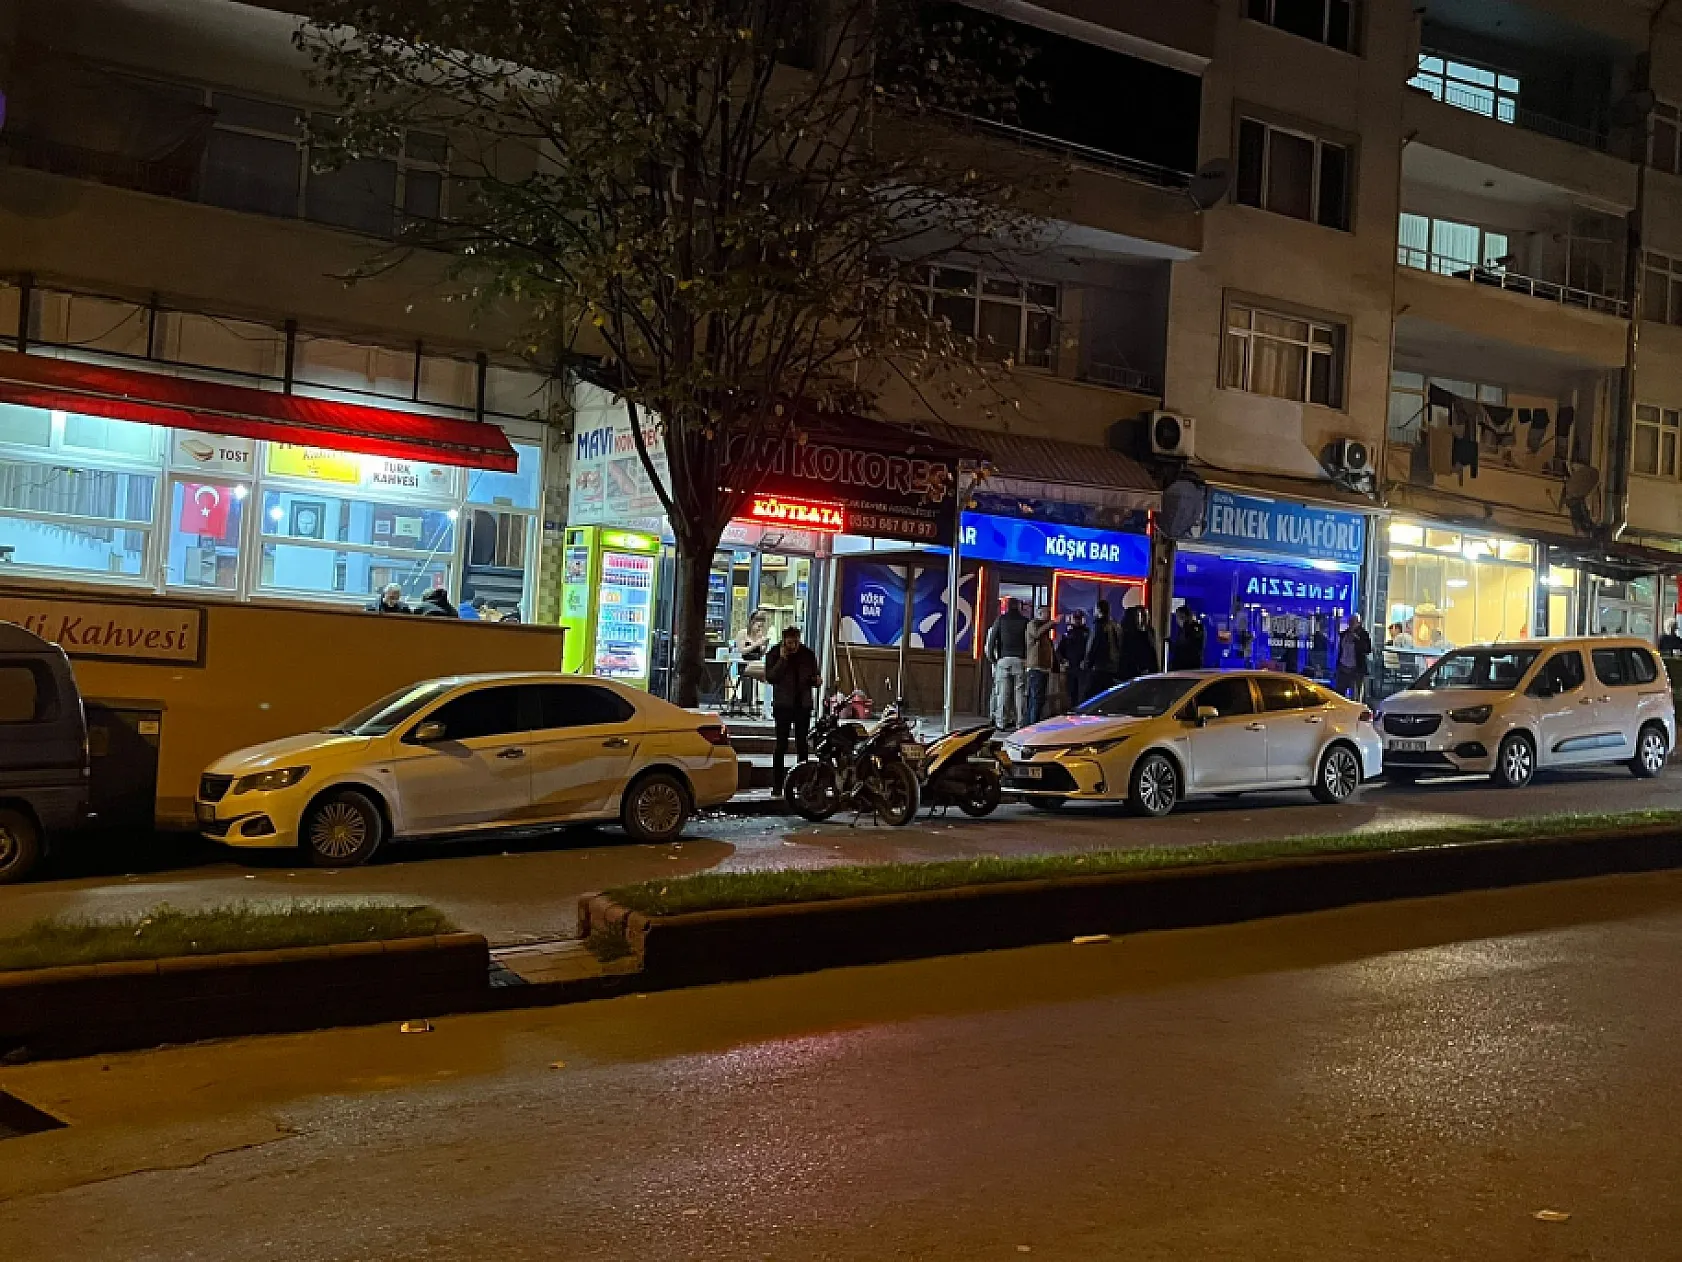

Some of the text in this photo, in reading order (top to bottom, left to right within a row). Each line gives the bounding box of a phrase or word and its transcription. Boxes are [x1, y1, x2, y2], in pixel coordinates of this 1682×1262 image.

[218, 447, 249, 462] TOST
[1210, 502, 1361, 551] ERKEK KUAFÖRÜ
[1045, 534, 1087, 560] KÖŞK
[1089, 541, 1121, 560] BAR
[862, 604, 881, 617] BAR
[58, 615, 188, 649] Kahvesi
